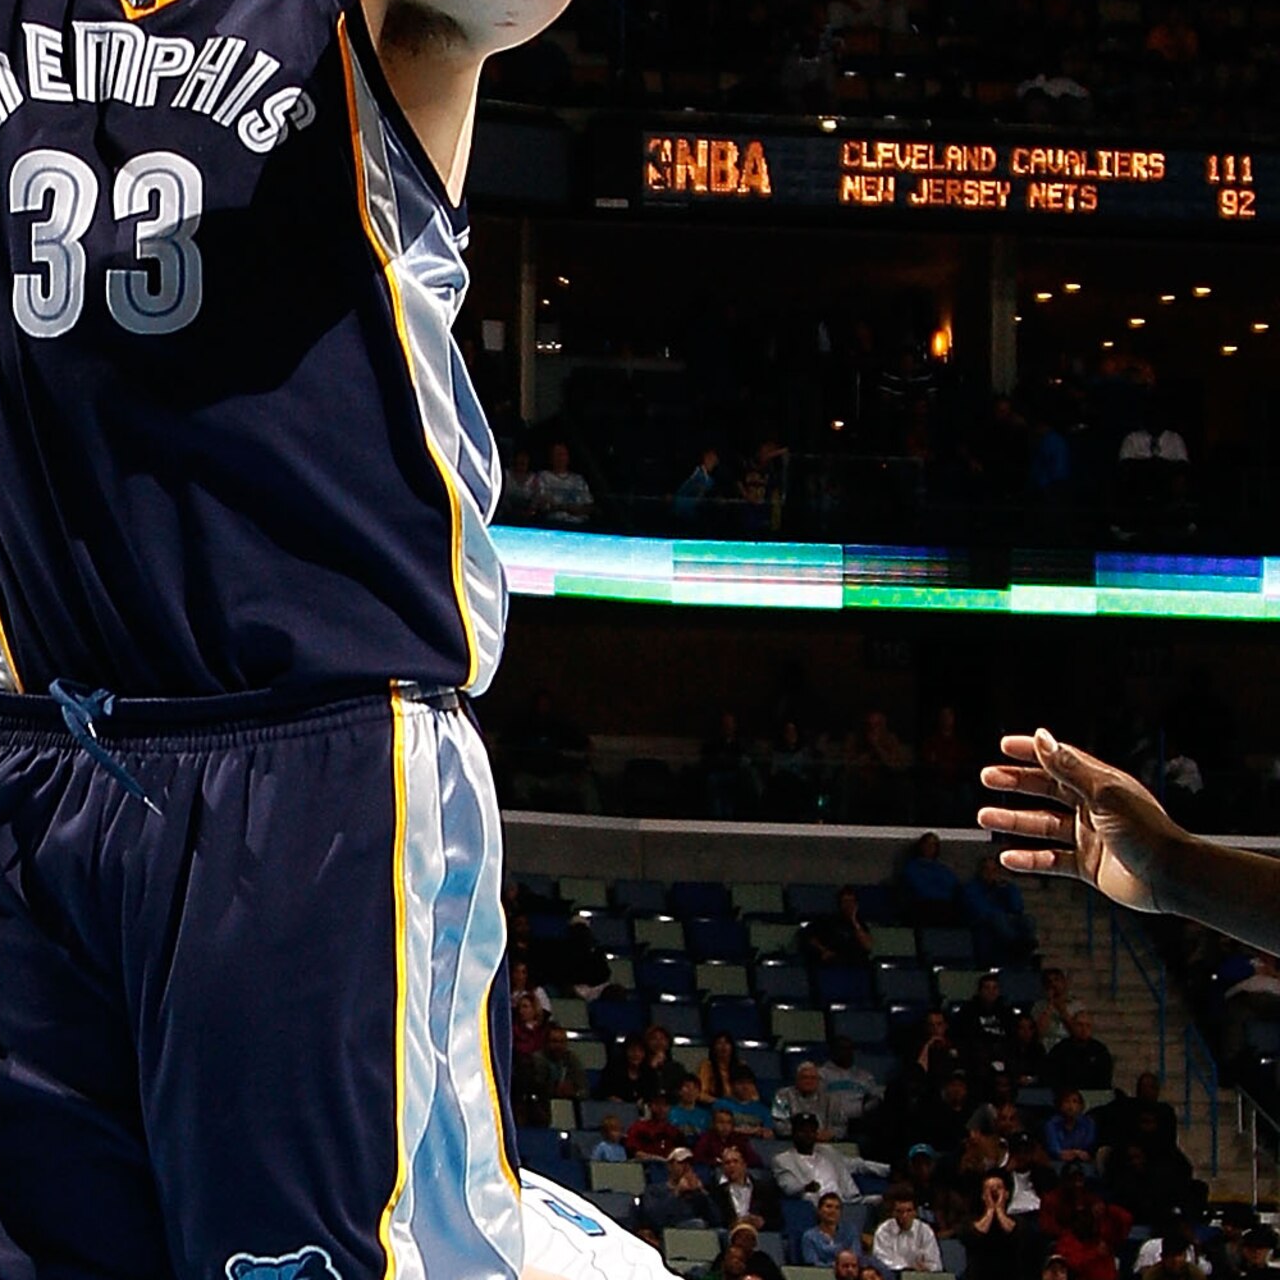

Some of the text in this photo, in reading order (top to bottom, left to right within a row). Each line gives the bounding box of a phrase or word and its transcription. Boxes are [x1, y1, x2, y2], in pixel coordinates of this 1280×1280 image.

[842, 141, 1253, 182] CLEVELAND CAVALIERS 111
[842, 175, 1256, 217] NEW JERSEY NETS 92
[8, 149, 203, 339] 33
